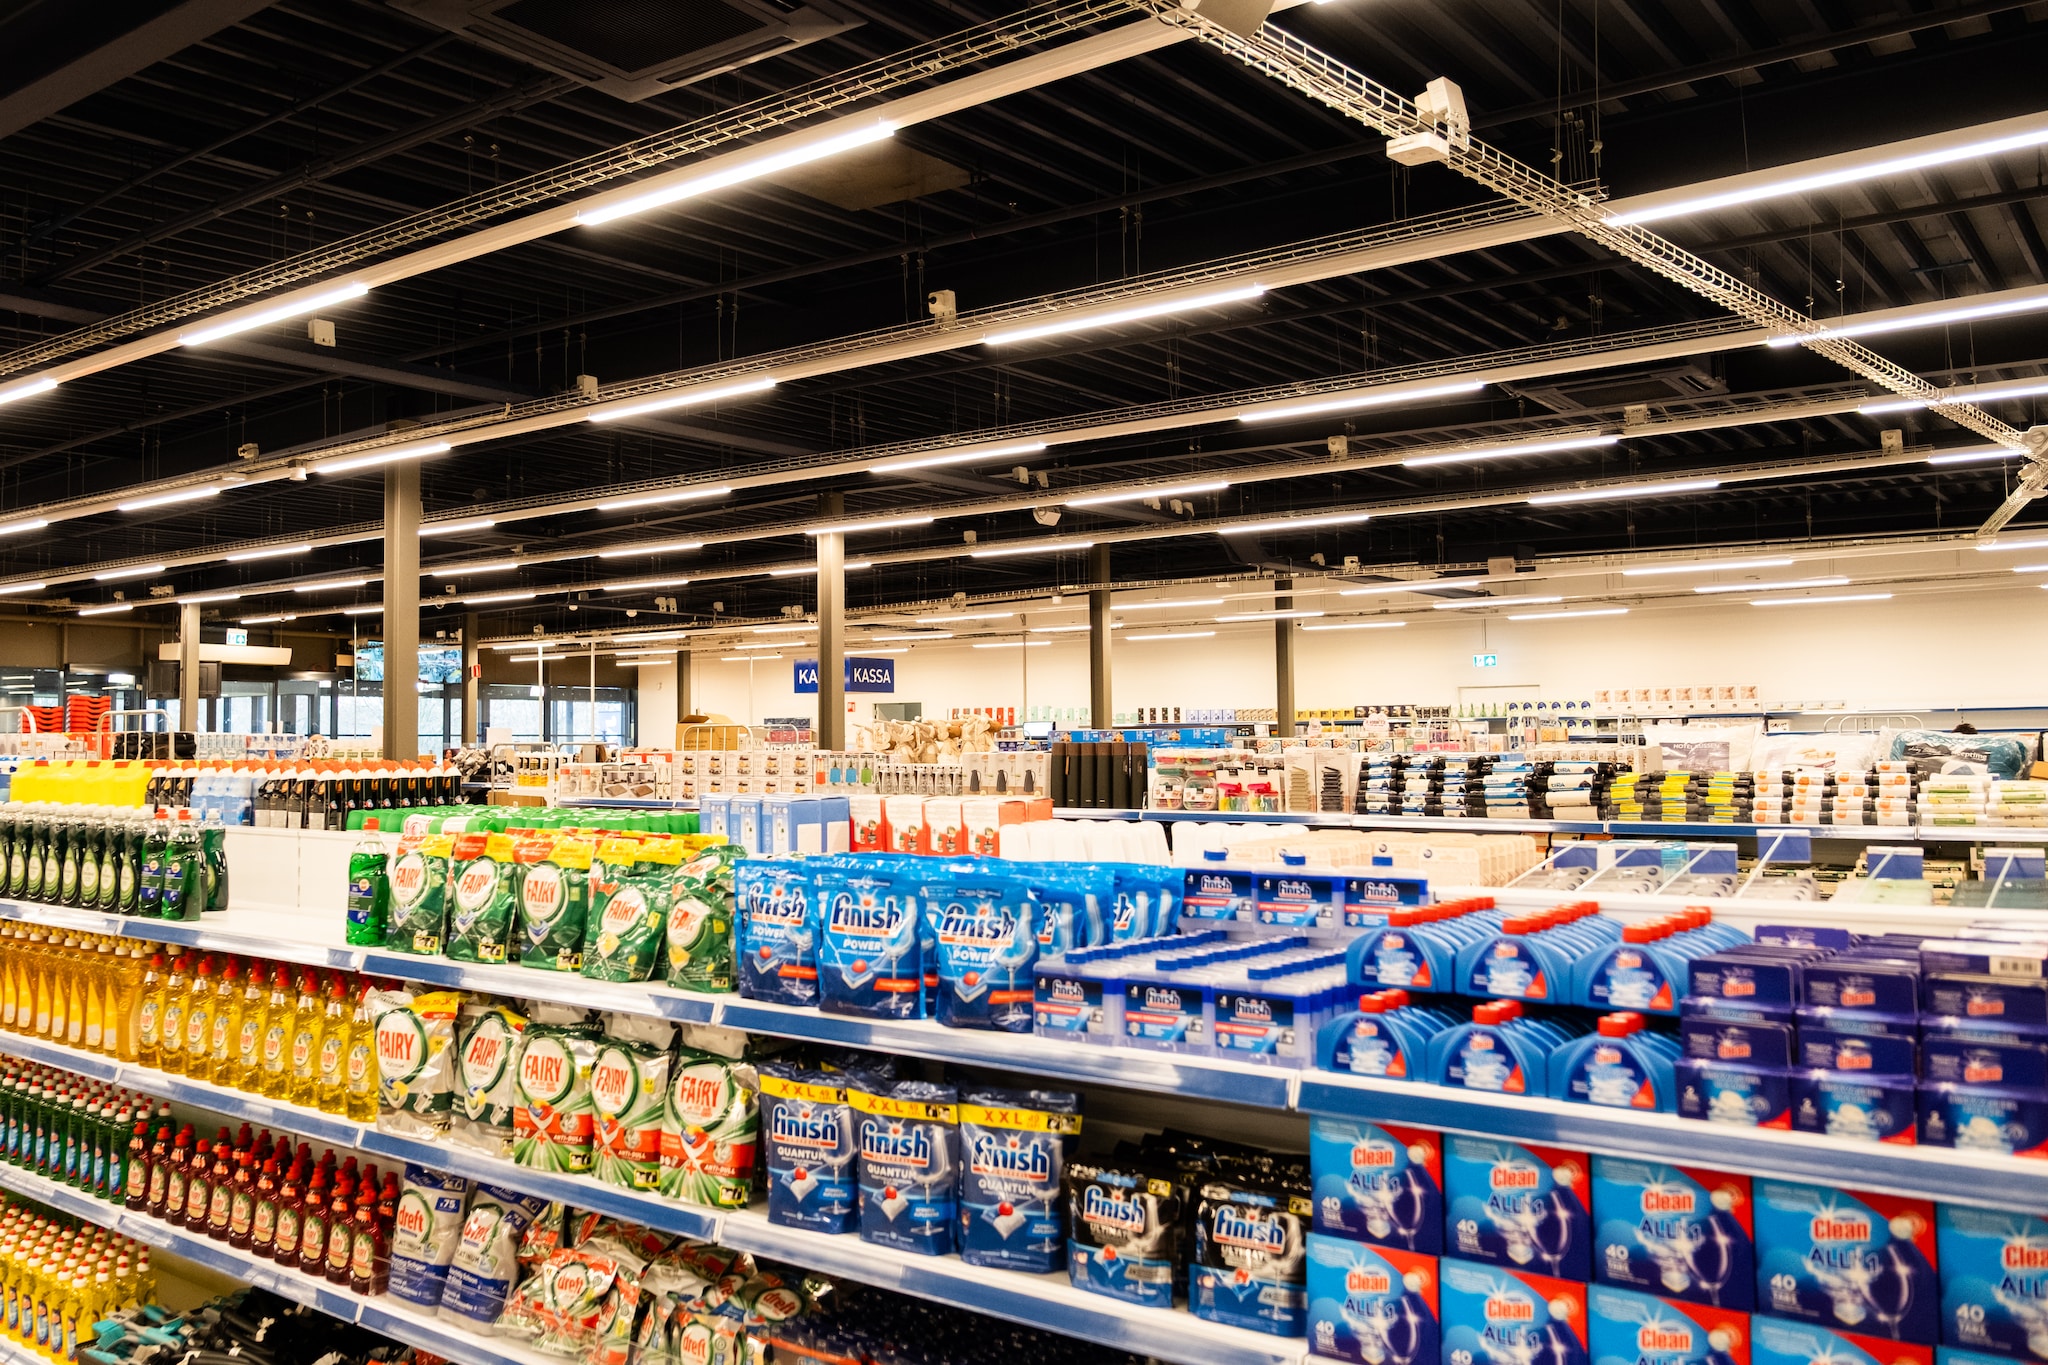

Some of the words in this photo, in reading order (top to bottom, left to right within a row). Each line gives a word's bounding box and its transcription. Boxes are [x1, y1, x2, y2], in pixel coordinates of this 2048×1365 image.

[799, 669, 818, 684] KA
[853, 668, 891, 684] KASSA
[395, 868, 421, 888] FAIRY
[460, 873, 490, 895] FAIRY
[1201, 876, 1232, 891] finish
[526, 880, 557, 903] FAIRY
[1279, 881, 1311, 896] finish
[1365, 883, 1397, 899] finish
[607, 899, 640, 921] FAIRY
[750, 883, 806, 919] finish
[832, 894, 901, 929] finish
[941, 904, 1016, 940] finish
[843, 939, 882, 951] POWER
[1053, 980, 1083, 998] finish
[1147, 989, 1180, 1008] finish
[1236, 998, 1271, 1017] finish
[379, 1030, 415, 1061] FAIRY
[468, 1036, 501, 1068] FAIRY
[525, 1055, 563, 1082] FAIRY
[595, 1066, 629, 1096] FAIRY
[780, 1081, 815, 1098] XXL
[680, 1076, 721, 1107] FAIRY
[867, 1097, 904, 1113] XXL
[773, 1106, 836, 1141] finish
[984, 1110, 1023, 1125] XXL
[862, 1122, 928, 1158] finish
[777, 1146, 827, 1161] QUANTUM
[972, 1135, 1047, 1173] finish
[1354, 1148, 1393, 1165] Clean
[703, 1164, 736, 1176] ANTI-DULL
[867, 1164, 917, 1179] QUANTUM
[1493, 1168, 1537, 1187] Clean
[978, 1179, 1036, 1194] QUANTUM
[1086, 1188, 1143, 1222] finish
[1321, 1196, 1341, 1211] 40
[1644, 1191, 1693, 1211] Clean
[398, 1205, 424, 1232] dreft
[1216, 1208, 1283, 1245] finish
[1457, 1219, 1478, 1234] 40
[1090, 1223, 1129, 1239] ULTIMAT
[1813, 1219, 1868, 1240] Clean
[1605, 1244, 1629, 1260] 40
[2005, 1245, 2048, 1269] Clea
[557, 1275, 584, 1295] dreft
[1348, 1272, 1388, 1291] Clean
[1770, 1273, 1796, 1291] 40
[763, 1291, 797, 1316] dreft
[1487, 1300, 1531, 1320] Clean
[1956, 1303, 1985, 1323] 40
[1315, 1320, 1335, 1335] 40
[682, 1332, 707, 1360] dreft
[1639, 1329, 1689, 1352] Clean
[1451, 1349, 1472, 1365] 40
